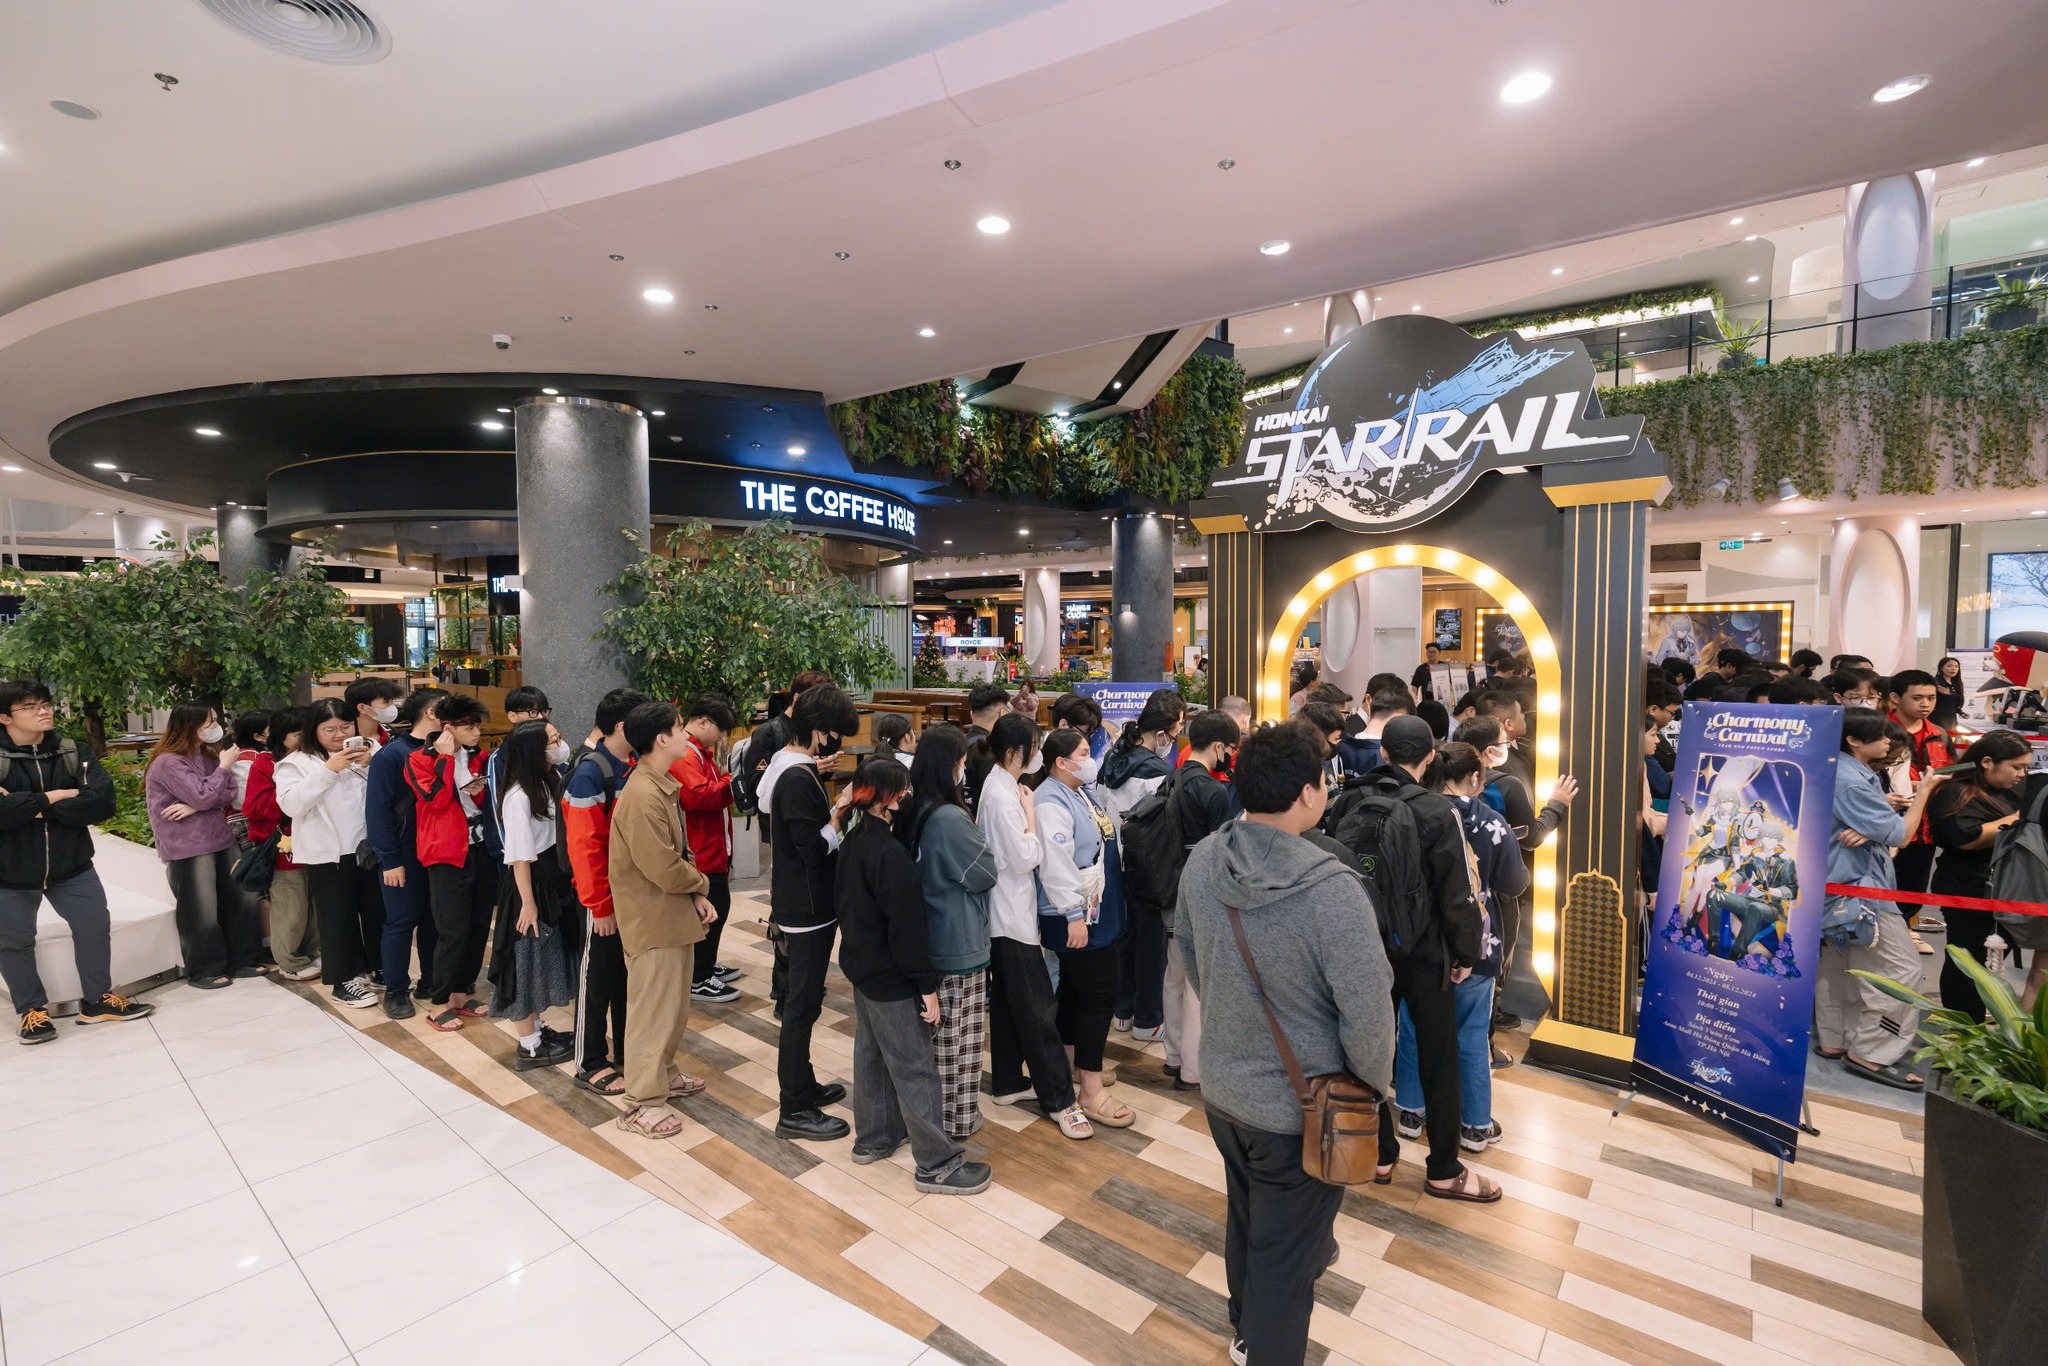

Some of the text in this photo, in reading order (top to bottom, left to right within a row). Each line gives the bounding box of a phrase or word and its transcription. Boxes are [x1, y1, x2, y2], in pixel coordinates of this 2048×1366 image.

[1254, 405, 1329, 432] HONKAI
[1212, 391, 1629, 509] STAR RAIL
[740, 481, 915, 536] THE COFFEE HOUSE
[1101, 699, 1148, 710] Carnival
[1712, 712, 1806, 735] Charmony
[1718, 728, 1788, 745] Carnival
[1697, 988, 1740, 1010] Thời gian
[1713, 1021, 1737, 1034] điểm
